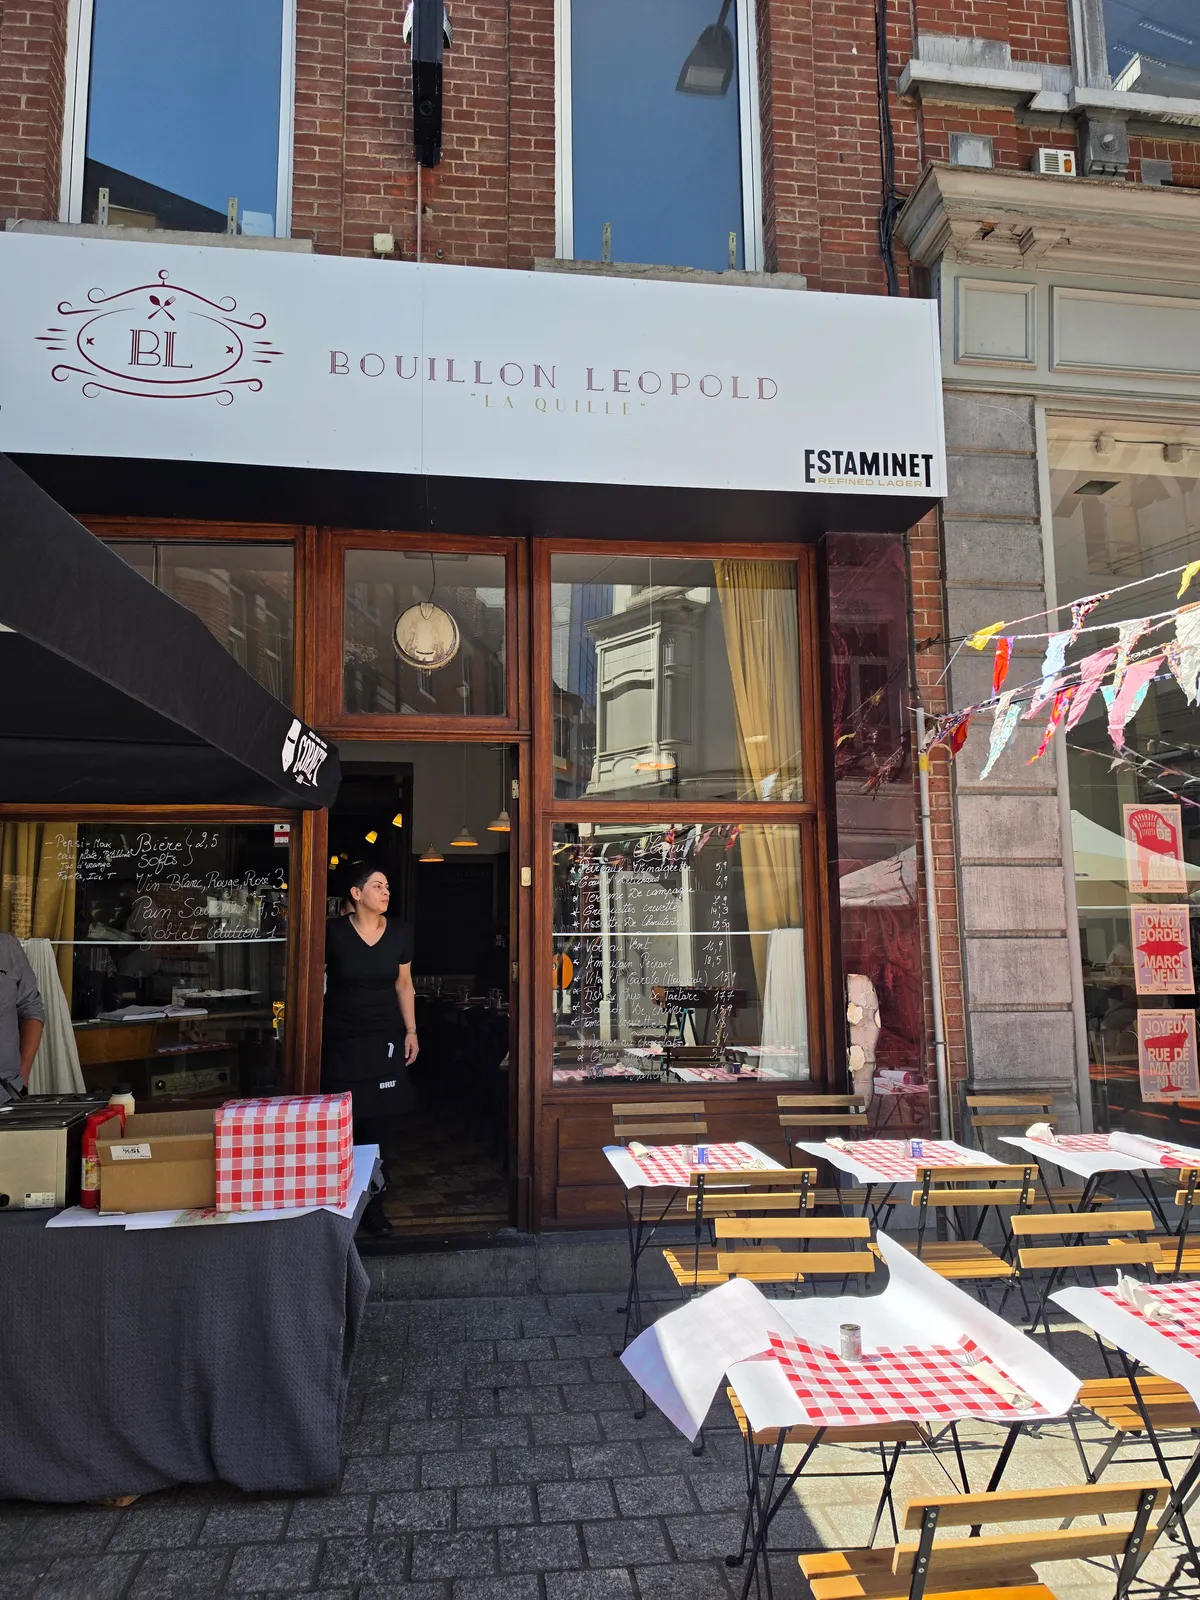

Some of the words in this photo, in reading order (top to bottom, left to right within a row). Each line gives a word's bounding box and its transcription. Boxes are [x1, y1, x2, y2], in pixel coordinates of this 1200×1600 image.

[128, 329, 193, 368] BL
[329, 350, 556, 389] BOUILLON
[585, 367, 778, 400] LEOPOLD
[804, 449, 933, 488] ESTAMINET
[818, 477, 874, 486] REFINED
[878, 479, 923, 488] LAGER
[136, 873, 160, 893] Vin
[273, 868, 284, 890] 3
[132, 895, 171, 922] Pain
[1139, 915, 1182, 928] JOYEUX
[1138, 928, 1184, 942] BORDEL
[1144, 955, 1184, 969] MARCI
[1145, 1020, 1189, 1034] JOYEUX
[1148, 1047, 1171, 1061] RUE
[1174, 1047, 1189, 1061] DE
[1150, 1061, 1189, 1076] MARCI
